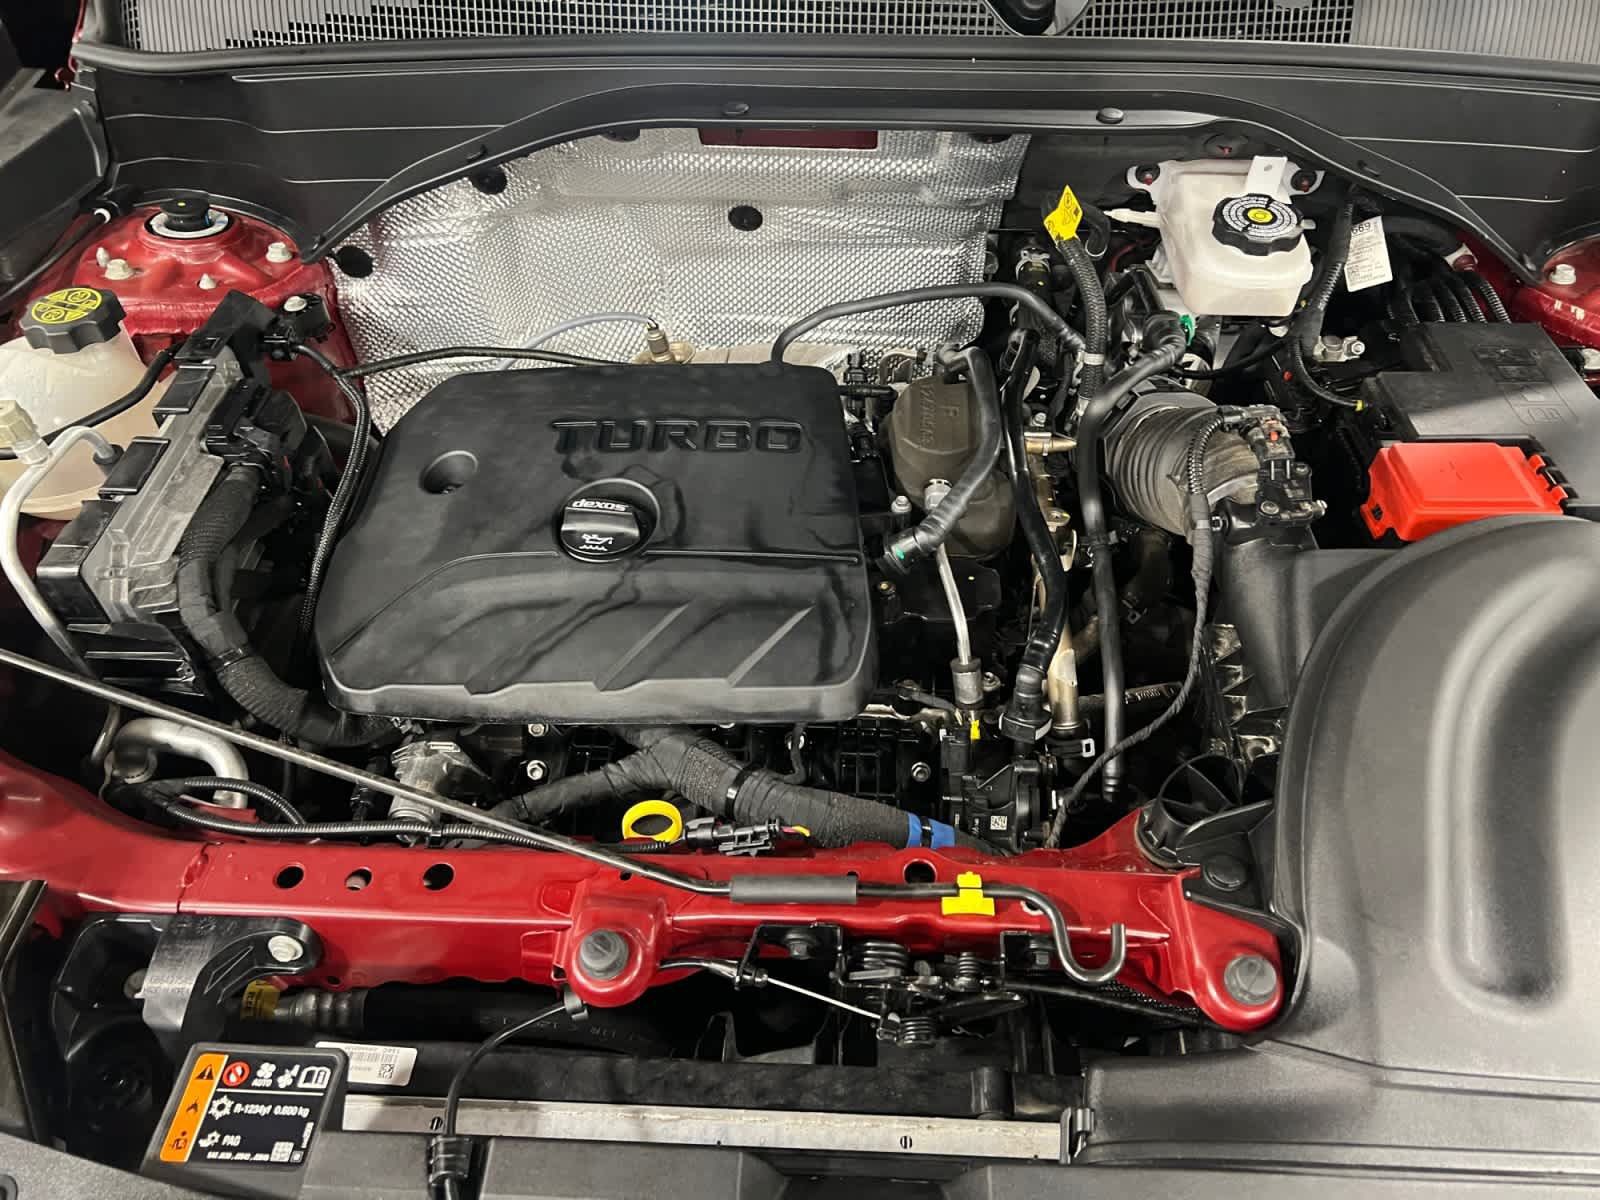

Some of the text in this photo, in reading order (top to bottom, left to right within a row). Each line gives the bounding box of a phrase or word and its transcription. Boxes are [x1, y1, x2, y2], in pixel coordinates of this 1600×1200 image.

[551, 418, 803, 454] TURBO
[572, 498, 627, 512] dexos
[251, 1078, 273, 1088] AUTO
[298, 1106, 310, 1118] kg
